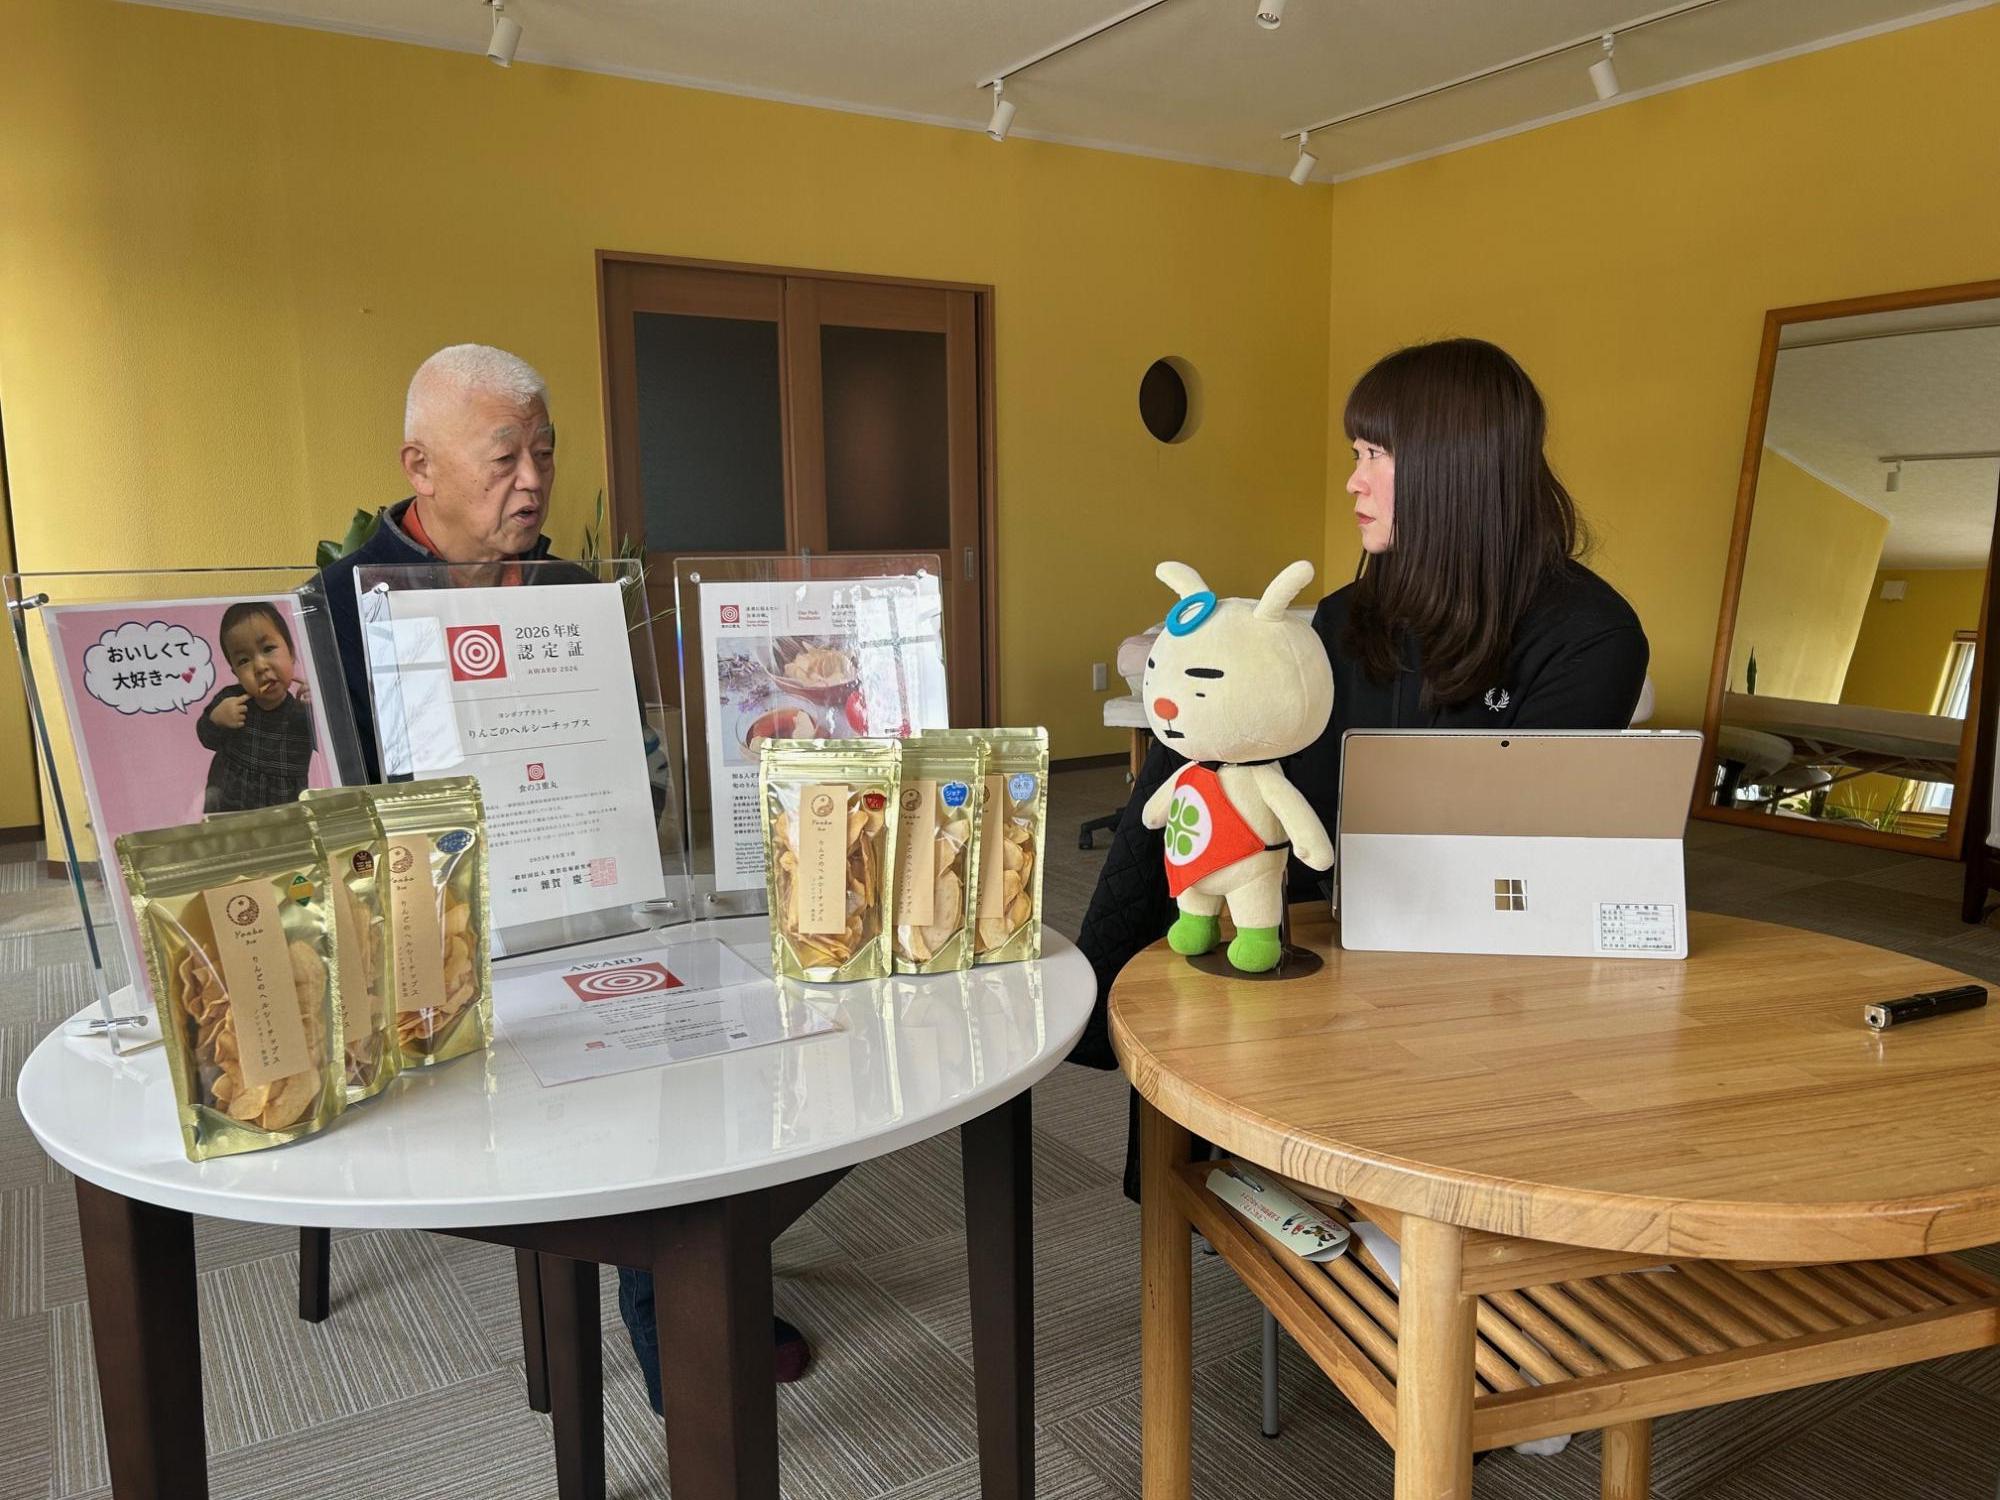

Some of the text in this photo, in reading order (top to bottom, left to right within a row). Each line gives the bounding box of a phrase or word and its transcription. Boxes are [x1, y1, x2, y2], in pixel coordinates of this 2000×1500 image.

[515, 623, 581, 639] 2026 年度
[106, 641, 191, 664] おいしくて
[517, 641, 584, 660] 認定証
[528, 667, 557, 675] AWARD
[468, 719, 590, 739] りんごのヘルシーチップス
[569, 956, 643, 972] AWARD
[252, 956, 281, 1064] りんごのヘルシーチップス
